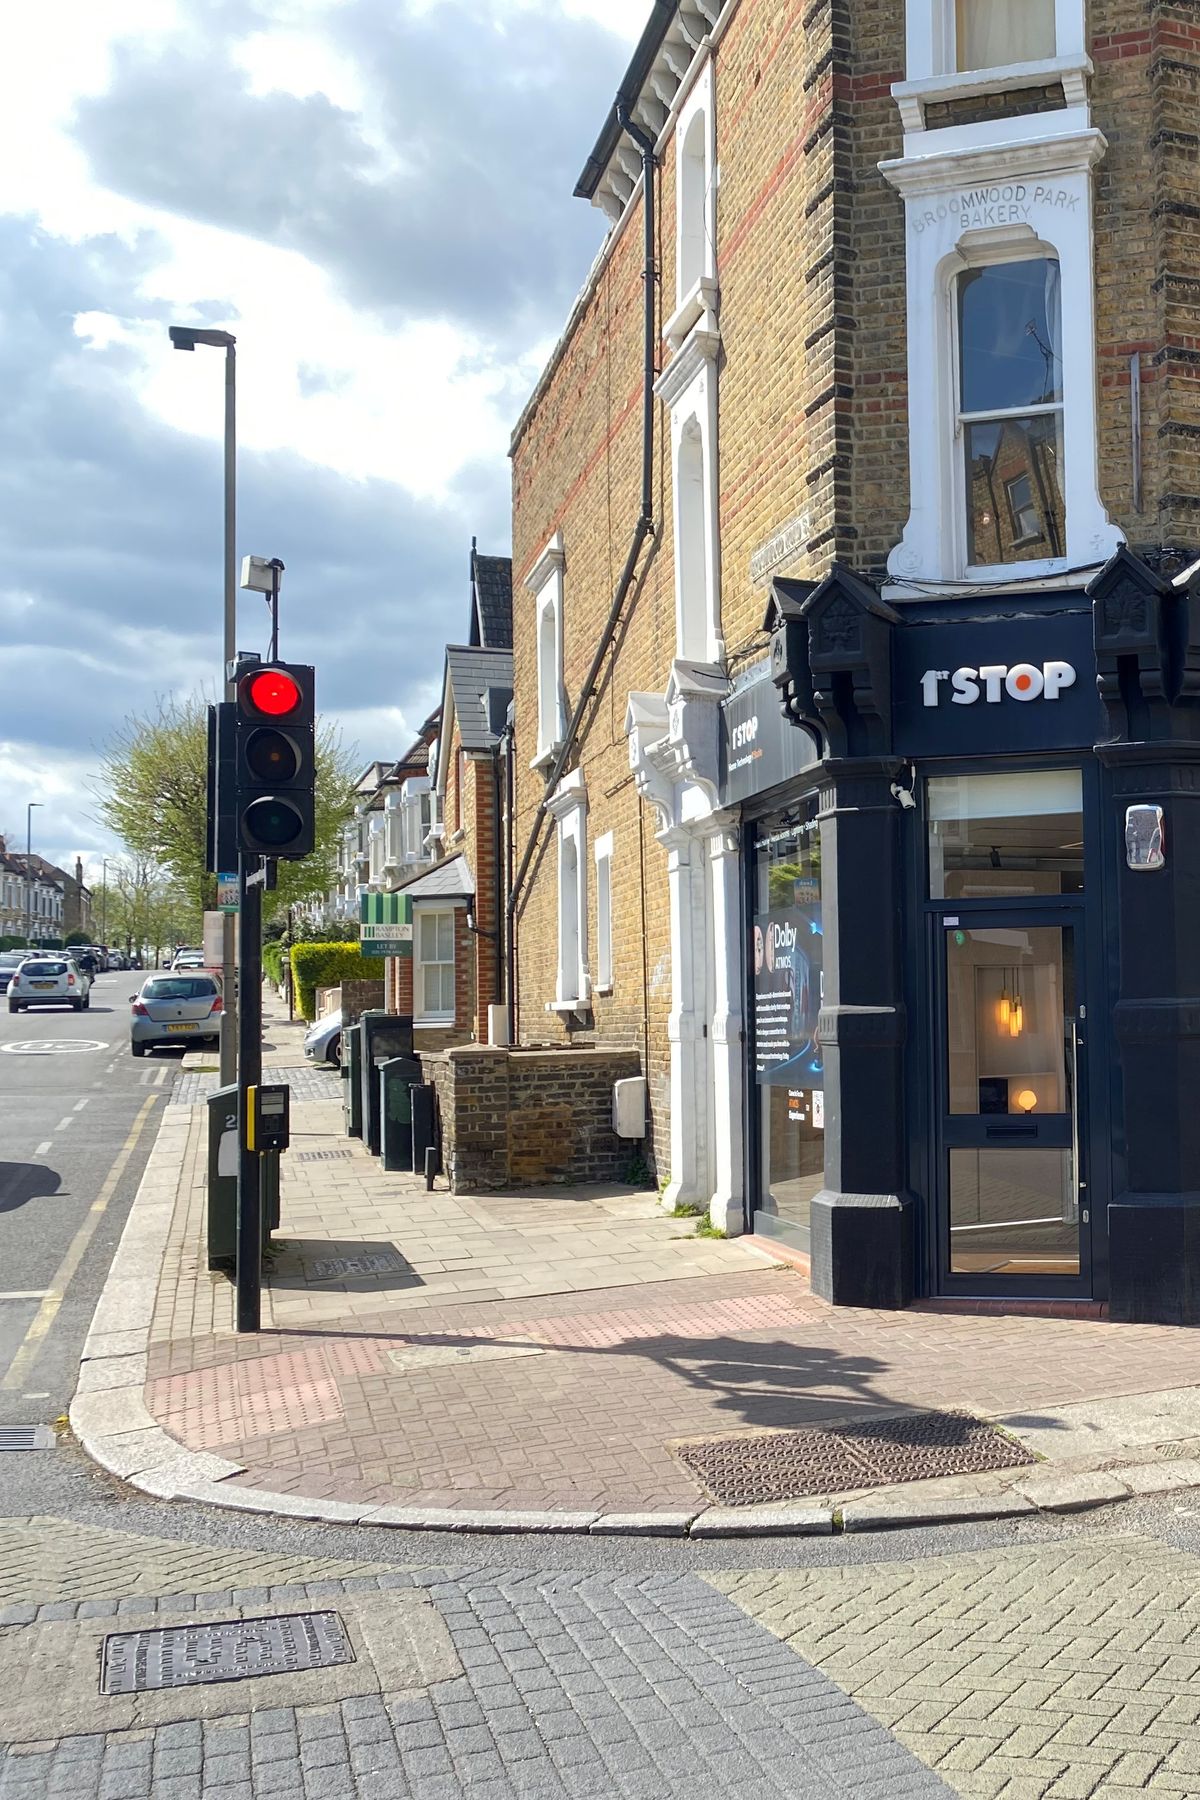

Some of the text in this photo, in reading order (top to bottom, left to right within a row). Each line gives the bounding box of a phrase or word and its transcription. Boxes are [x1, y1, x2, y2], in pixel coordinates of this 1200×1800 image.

[912, 185, 1080, 233] BROOMWOOD PARK
[960, 205, 1031, 228] BAKERY
[951, 661, 1077, 705] STOP
[737, 716, 759, 747] STOP
[774, 921, 797, 952] Dolby
[775, 956, 792, 969] ATMOS
